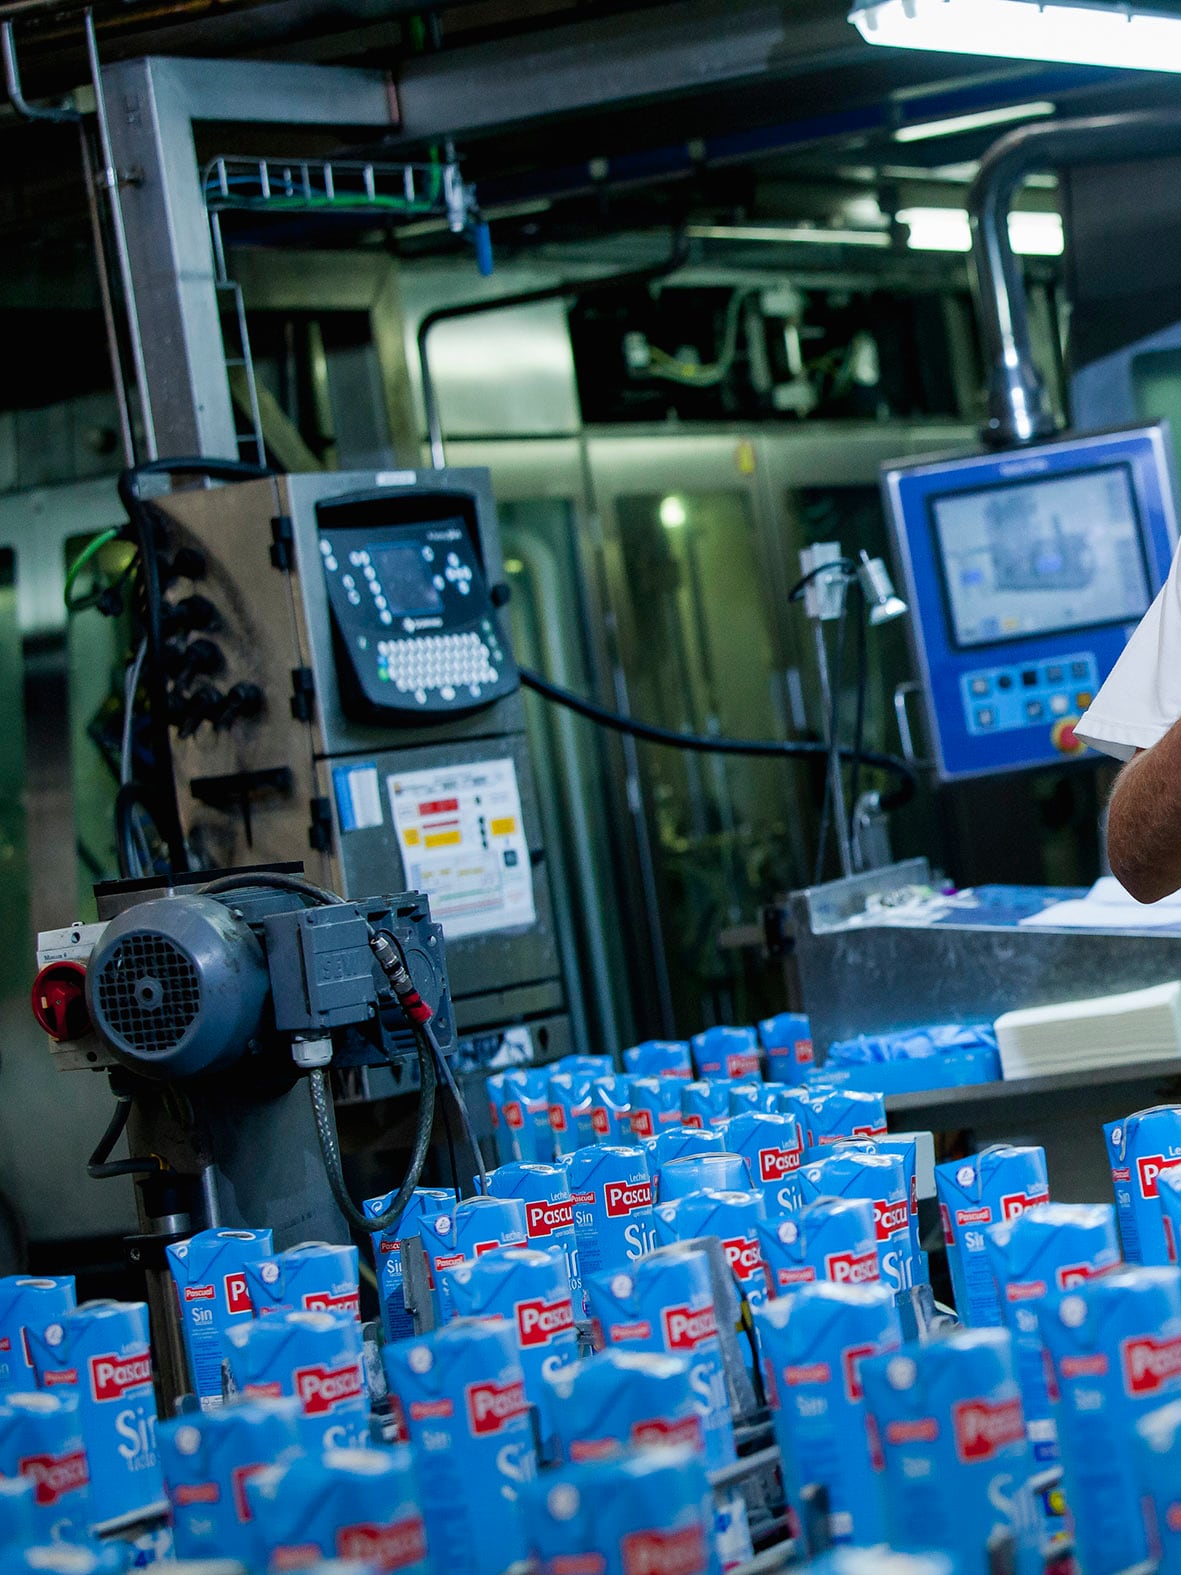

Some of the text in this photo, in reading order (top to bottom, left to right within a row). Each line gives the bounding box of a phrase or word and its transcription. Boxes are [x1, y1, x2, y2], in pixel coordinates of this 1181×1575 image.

[764, 1154, 800, 1172] Pascu
[630, 1174, 649, 1183] Leche
[610, 1187, 651, 1207] Pascu
[531, 1208, 572, 1226] Pascu
[576, 1211, 593, 1224] Sin
[873, 1207, 908, 1228] Pascu
[957, 1212, 989, 1222] Pascual
[381, 1242, 400, 1250] Pascu
[835, 1261, 878, 1282] Pascu
[185, 1287, 214, 1298] Pascual
[192, 1308, 212, 1322] Sin
[521, 1309, 573, 1335] Pascu
[98, 1359, 150, 1387] Pascu
[304, 1372, 361, 1400] Pascu
